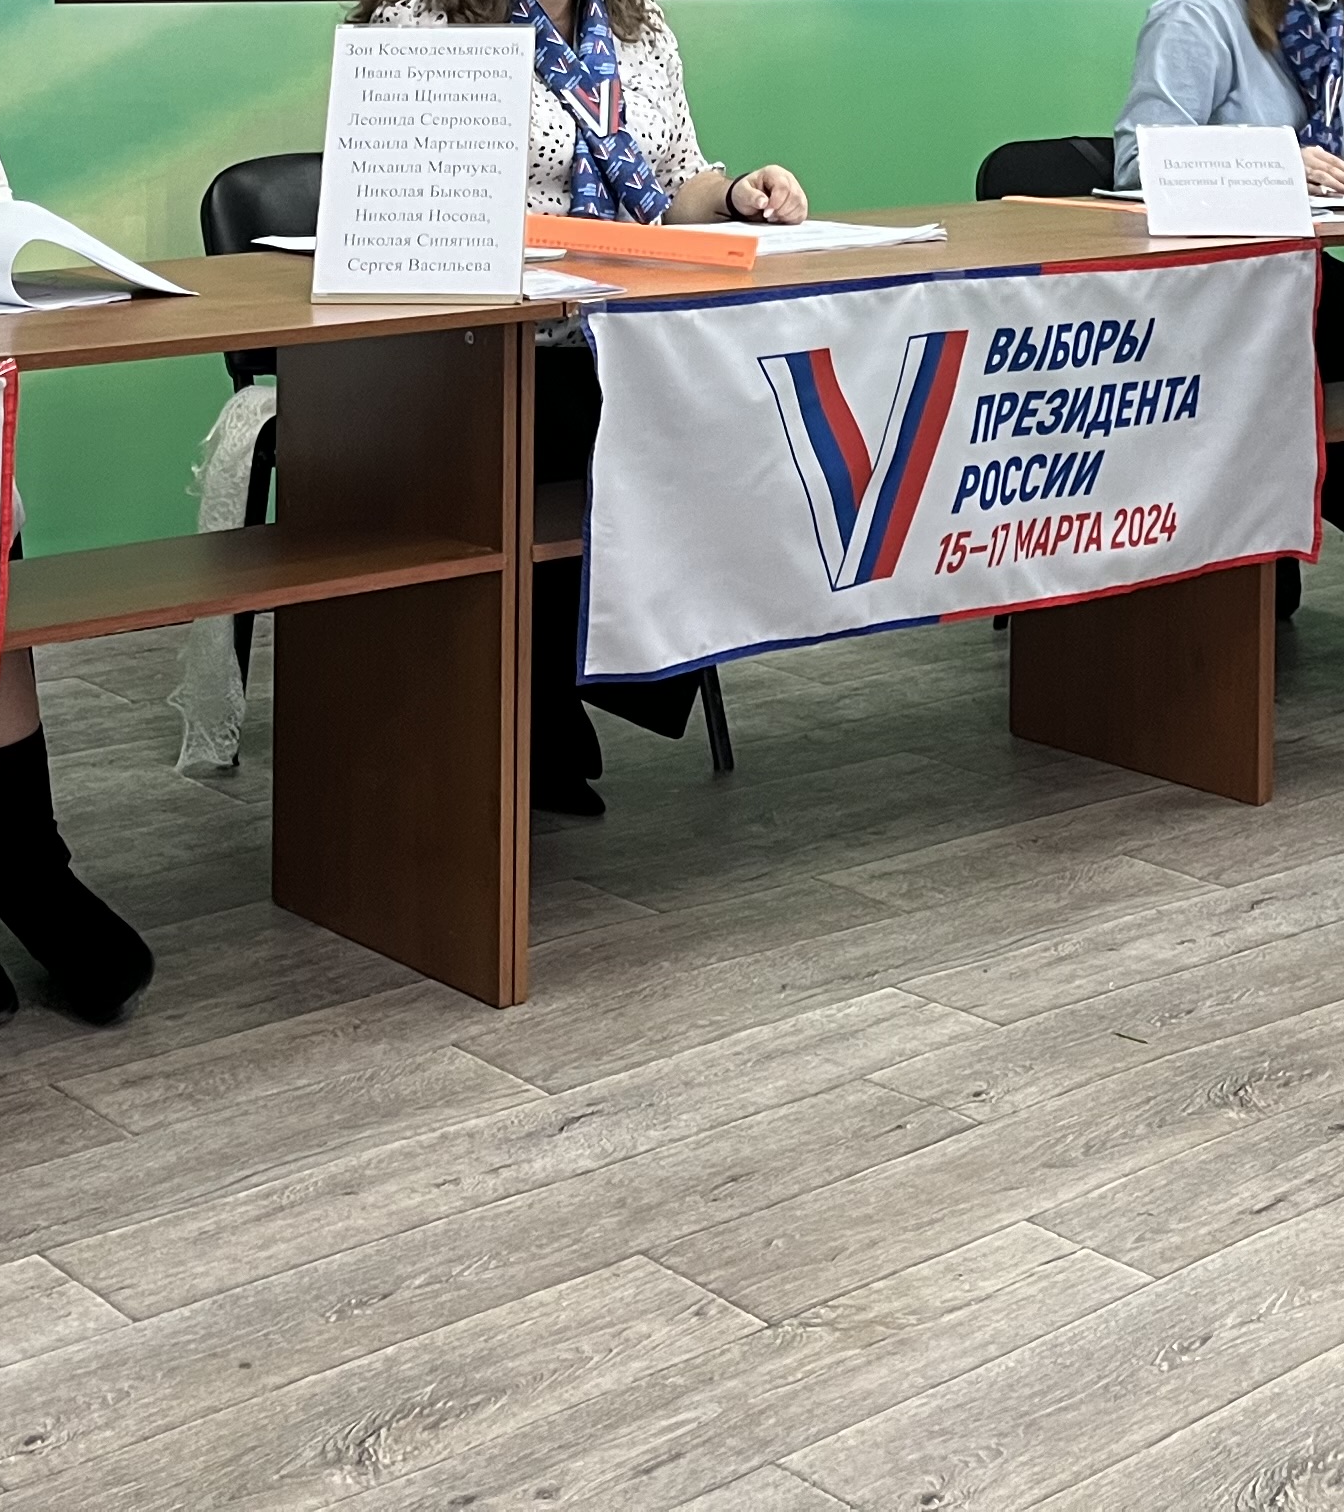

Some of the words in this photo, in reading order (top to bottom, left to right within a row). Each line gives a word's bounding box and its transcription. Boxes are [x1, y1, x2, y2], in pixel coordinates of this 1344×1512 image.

[355, 66, 401, 79] Ивана
[407, 66, 513, 82] Бурмистрова,
[362, 89, 409, 102] Ивана
[347, 113, 415, 127] Леонида
[337, 137, 408, 150] Михаила
[413, 137, 519, 153] Мартыненко,
[351, 160, 422, 174] Михаила
[427, 160, 502, 177] Марчука,
[356, 184, 424, 198] Николая
[430, 184, 493, 199] Быкова,
[355, 208, 423, 222] Николая
[428, 208, 491, 224] Носова,
[343, 233, 411, 247] Николая
[347, 257, 403, 275] Сергея
[409, 258, 491, 272] Васильева
[983, 317, 1156, 376] ВЫБОРЫ
[969, 374, 1201, 444] ПРЕЗИДЕНТА
[951, 450, 1106, 515] РОССИИ
[1013, 511, 1103, 563] МАРТА
[1110, 502, 1177, 550] 2024
